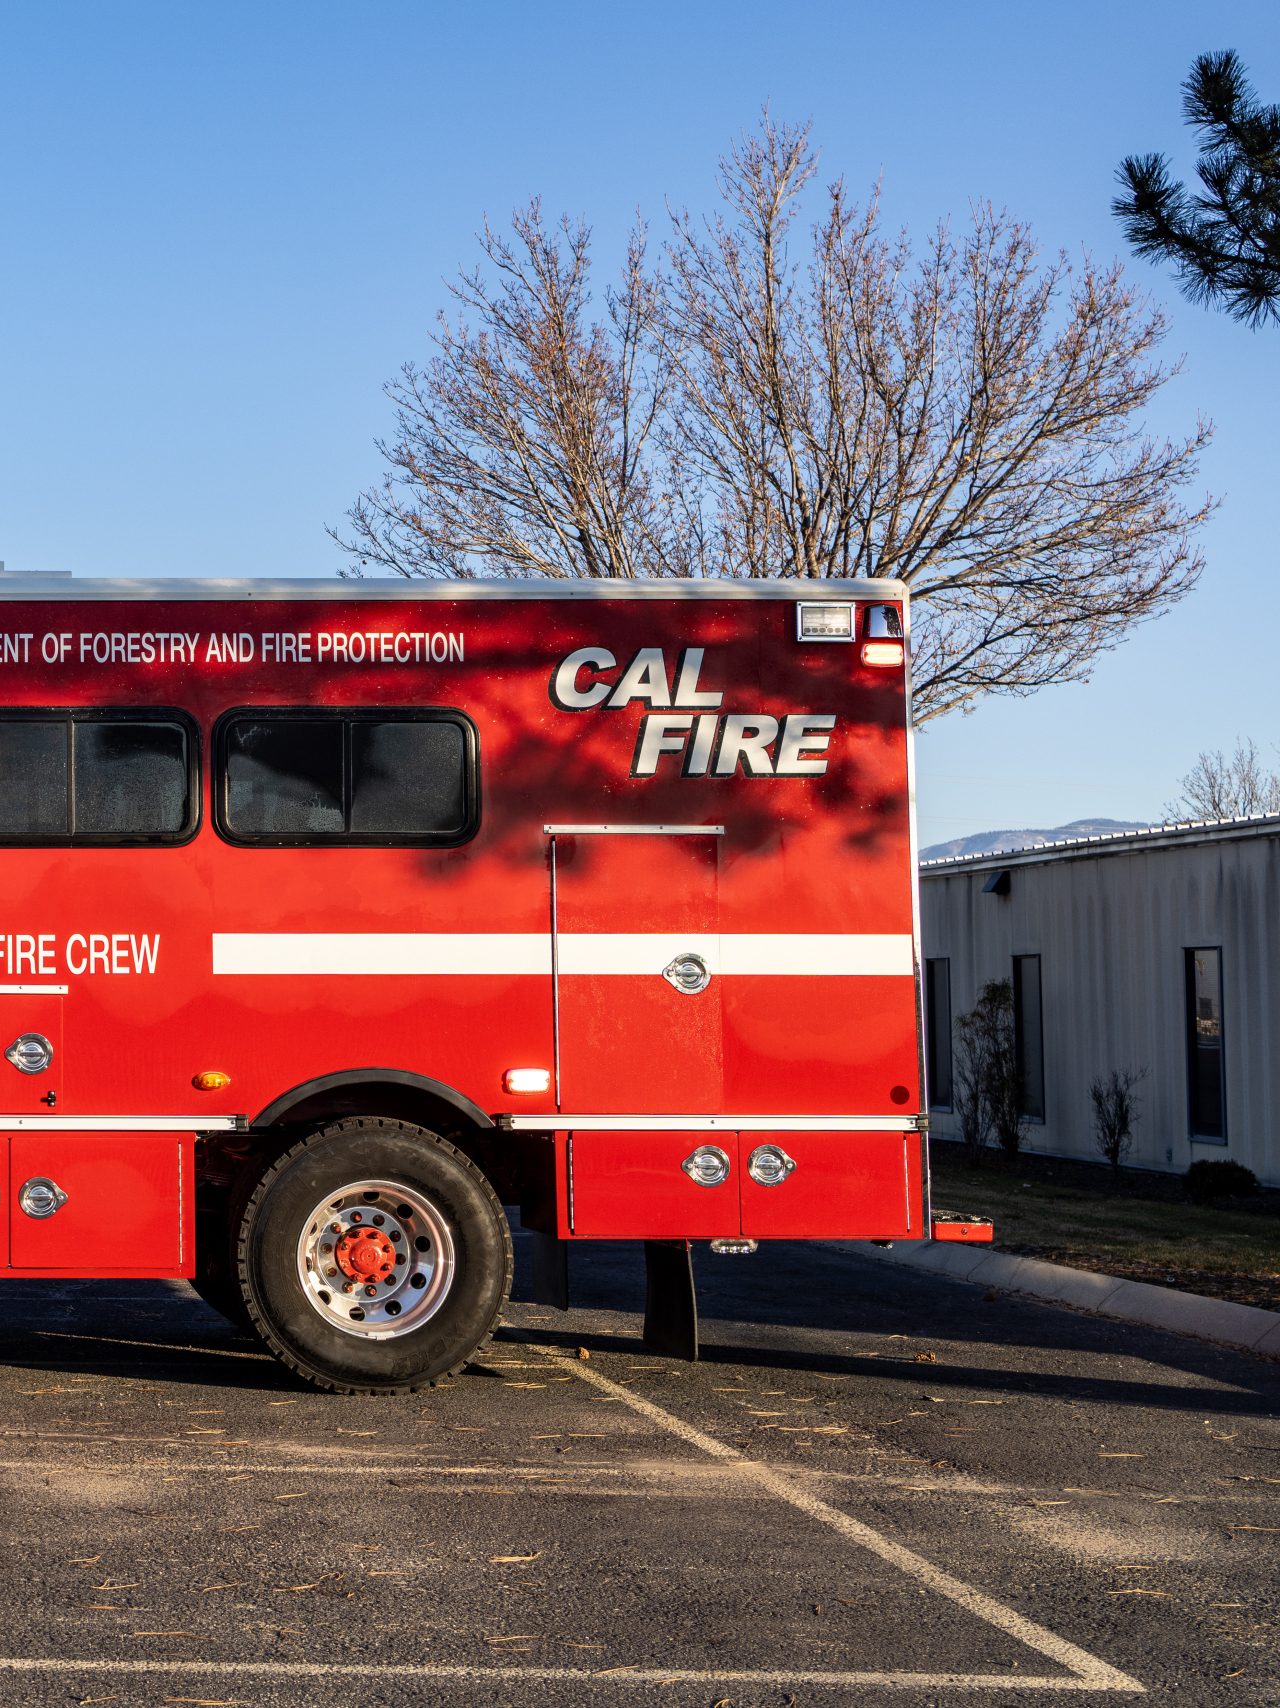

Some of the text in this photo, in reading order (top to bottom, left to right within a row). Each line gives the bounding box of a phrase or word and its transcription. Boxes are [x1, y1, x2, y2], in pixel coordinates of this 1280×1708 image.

[41, 632, 73, 664] OF
[79, 632, 200, 664] FORESTRY
[205, 632, 255, 663] AND
[261, 632, 312, 663] FIRE
[317, 631, 464, 663] PROTECTION
[552, 646, 724, 710] CAL
[632, 714, 837, 776] FIRE
[65, 933, 161, 975] CREW
